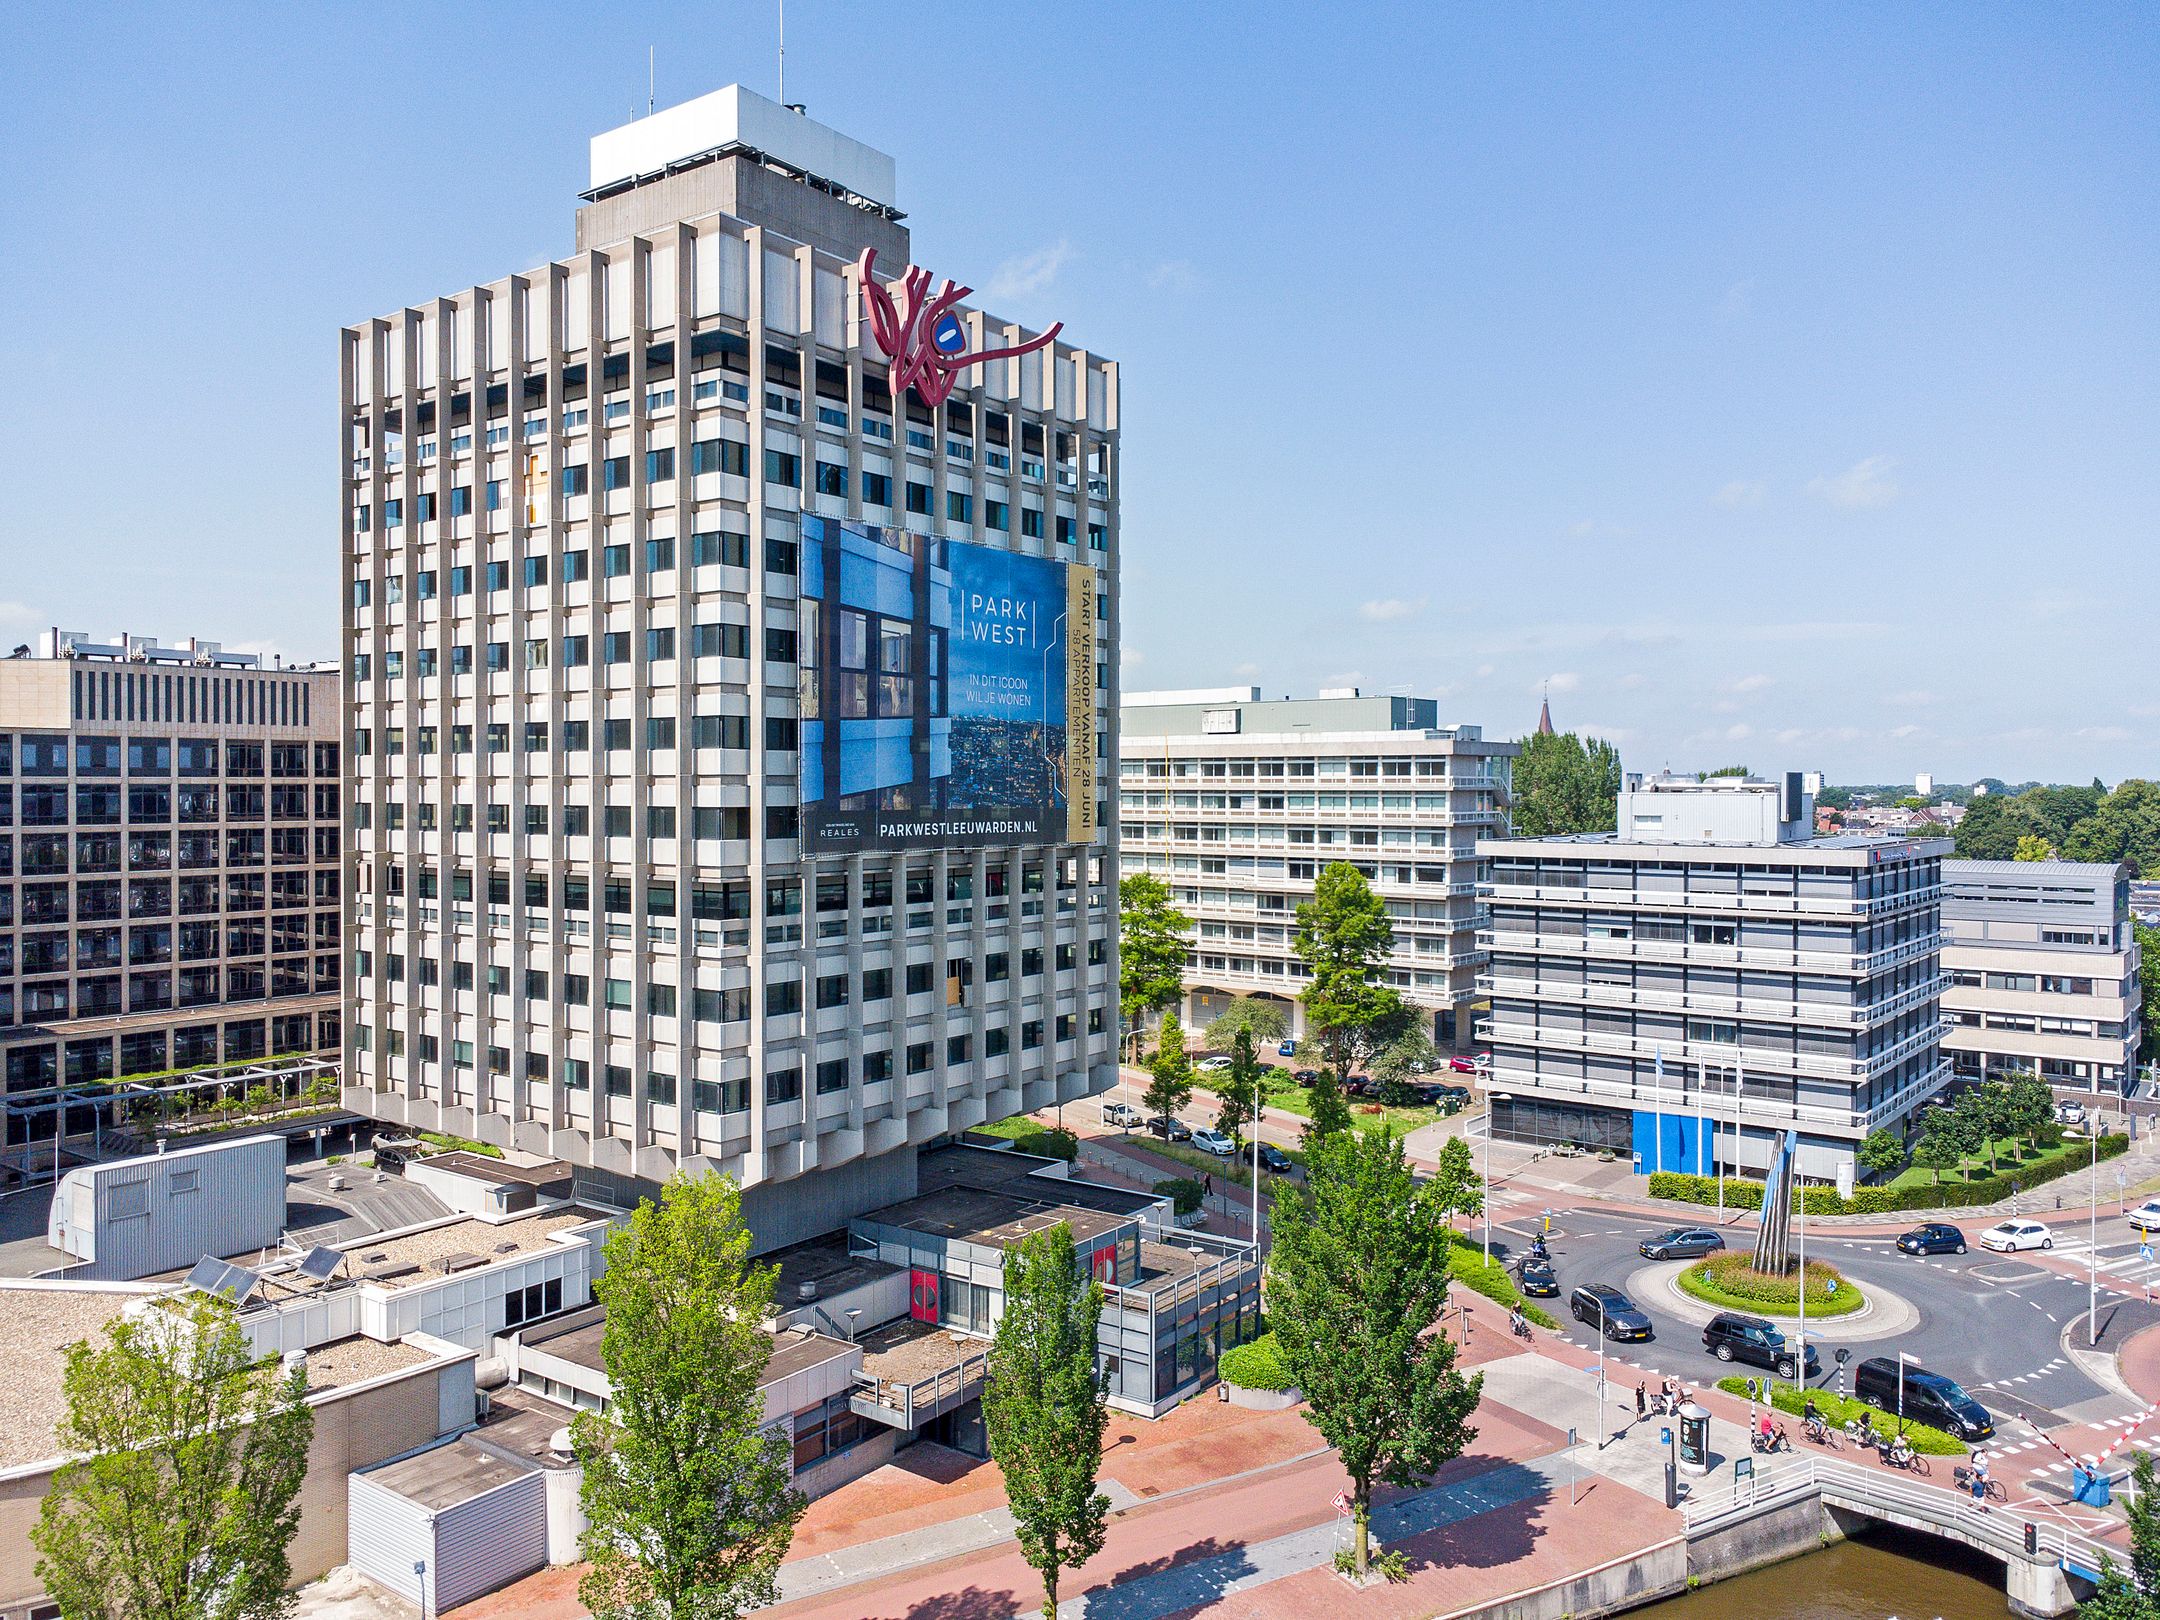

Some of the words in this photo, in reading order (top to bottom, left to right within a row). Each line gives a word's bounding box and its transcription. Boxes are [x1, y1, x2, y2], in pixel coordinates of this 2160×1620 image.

[972, 594, 1027, 621] PARK
[1082, 579, 1091, 629] START
[971, 621, 1027, 646] WEST
[1073, 629, 1081, 645] 58
[969, 673, 980, 686] IN
[981, 674, 997, 688] DIT
[998, 676, 1028, 690] ICOON
[1082, 634, 1091, 708] VERKOOP
[966, 690, 983, 703] WIL
[984, 692, 996, 704] JE
[998, 693, 1031, 706] WONEN
[1073, 648, 1081, 777] APPARTEMENTEN
[1082, 712, 1091, 765] VANAF
[1082, 769, 1091, 788] 28
[1082, 792, 1091, 828] JUNI
[820, 828, 860, 837] REALES
[880, 821, 1038, 837] PARKWESTLEEUWARDEN.NL
